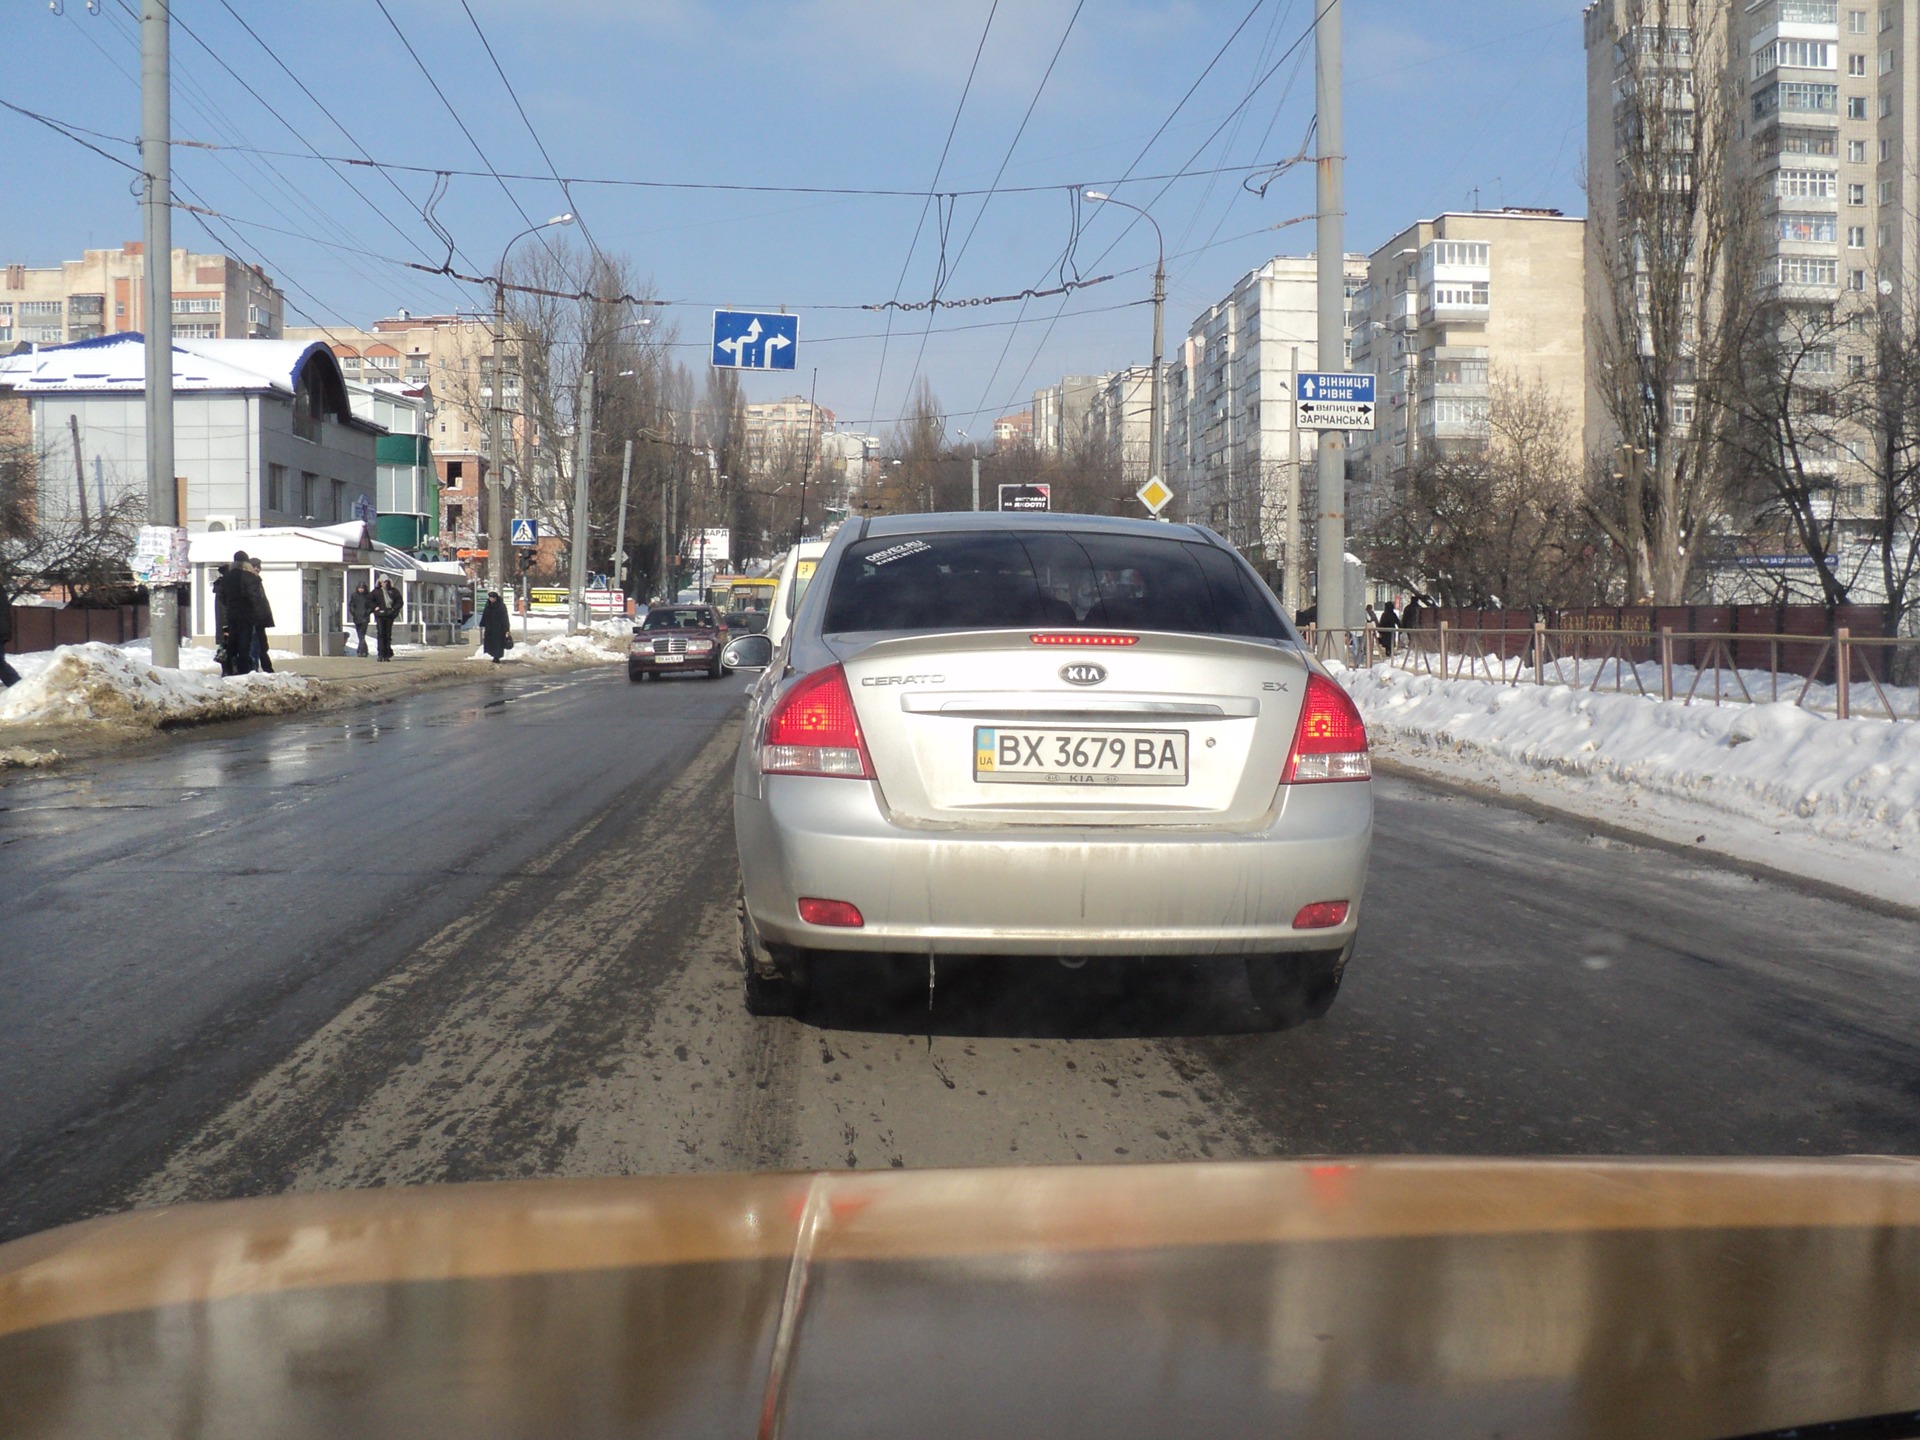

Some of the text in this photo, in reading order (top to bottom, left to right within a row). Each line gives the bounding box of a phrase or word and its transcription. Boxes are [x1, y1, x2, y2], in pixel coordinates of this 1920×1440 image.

[1319, 376, 1369, 389] ВІННИЦЯ
[1319, 389, 1353, 399] РІВНЕ
[1316, 404, 1356, 413] ВУЛИЦЯ
[1300, 414, 1370, 425] ЗАРІЧАНСЬКА
[865, 540, 923, 561] DRIVE2.RU
[1068, 666, 1099, 680] KIA
[861, 673, 946, 687] CERATO
[1263, 682, 1289, 692] EX
[999, 735, 1178, 770] BX 3679 BA
[979, 757, 993, 766] UA
